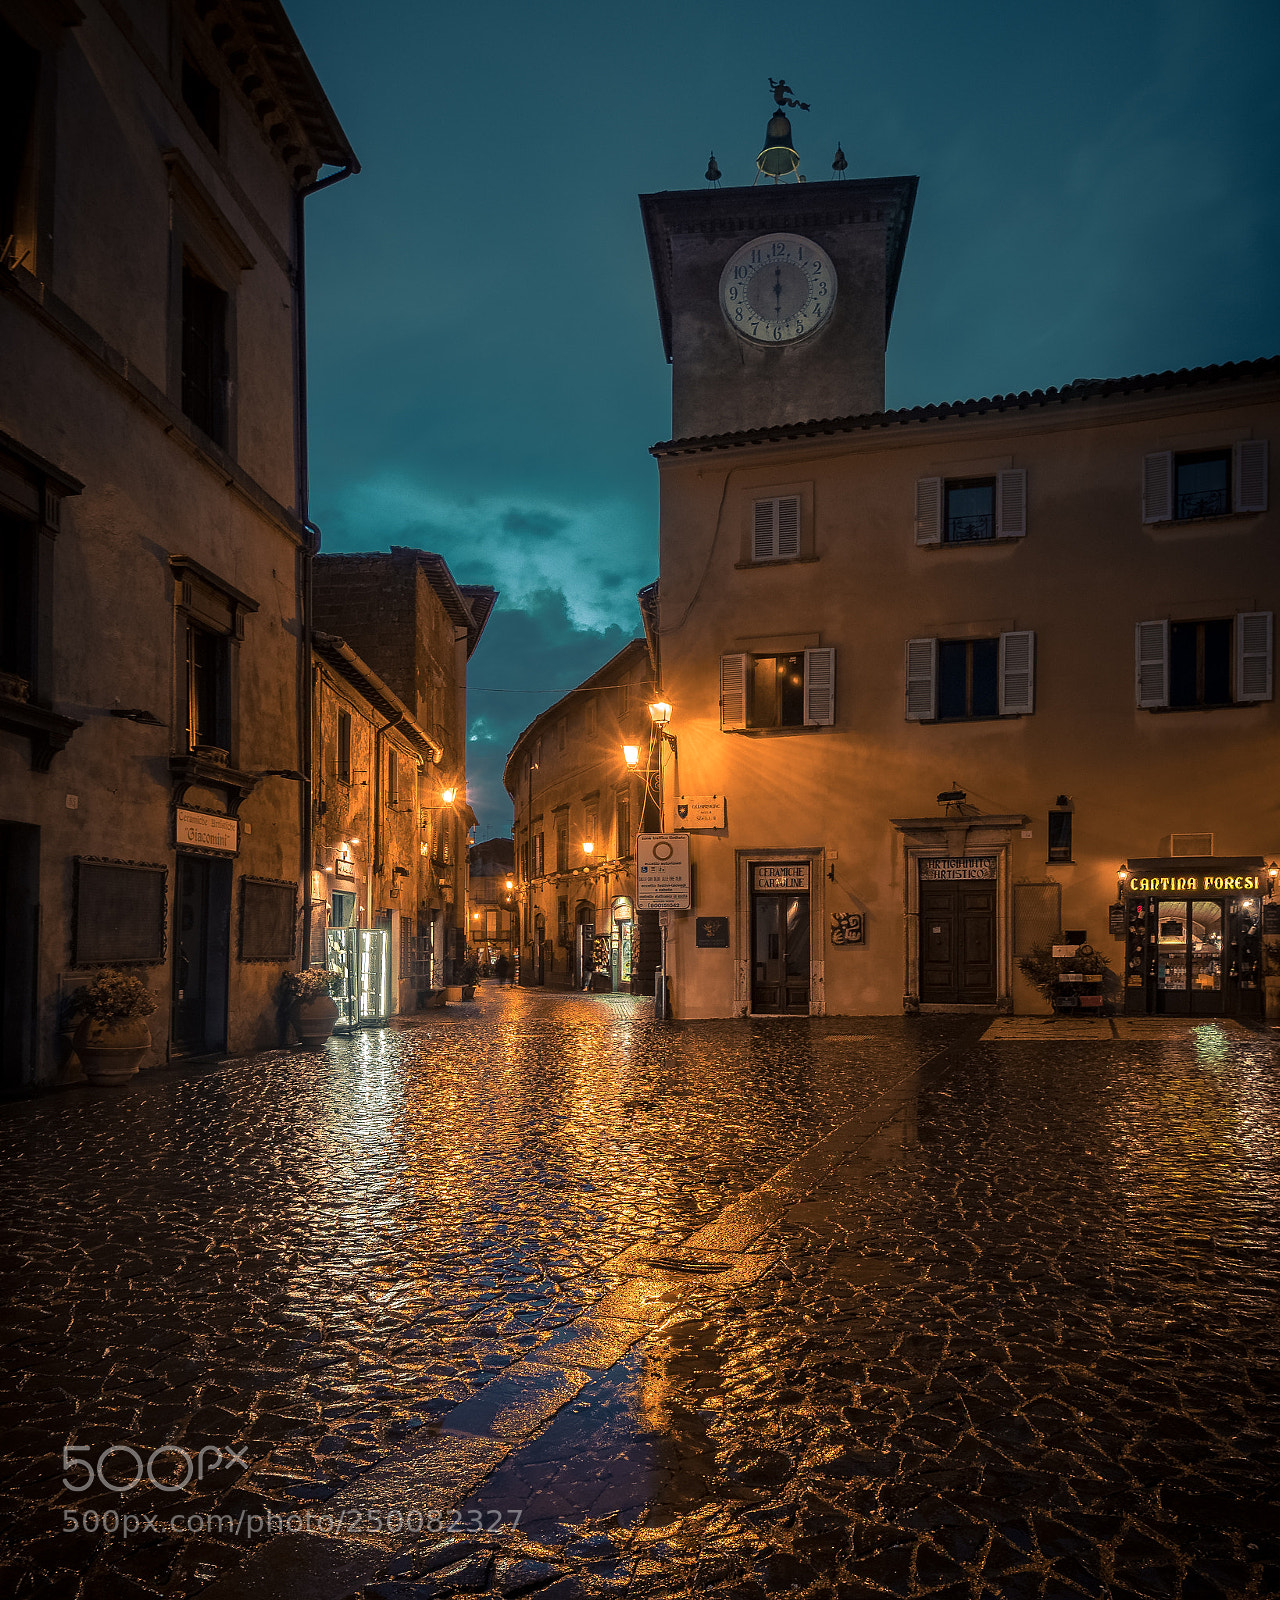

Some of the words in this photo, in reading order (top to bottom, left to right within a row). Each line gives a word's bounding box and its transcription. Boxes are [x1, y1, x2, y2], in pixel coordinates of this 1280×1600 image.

[752, 249, 761, 263] 11
[772, 242, 786, 257] 12
[798, 246, 803, 261] 1
[734, 265, 748, 279] 10
[812, 261, 822, 275] 2
[729, 286, 738, 300] 9
[818, 281, 828, 296] 3
[735, 307, 743, 321] 8
[812, 303, 823, 317] 4
[750, 322, 759, 336] 7
[796, 319, 804, 334] 5
[773, 327, 782, 341] 6
[759, 867, 804, 877] CERAMICHE
[934, 869, 984, 879] ARTISTICO
[759, 878, 804, 888] CARTOLINE
[1130, 877, 1198, 891] CANTINA
[1203, 876, 1259, 890] FORESI
